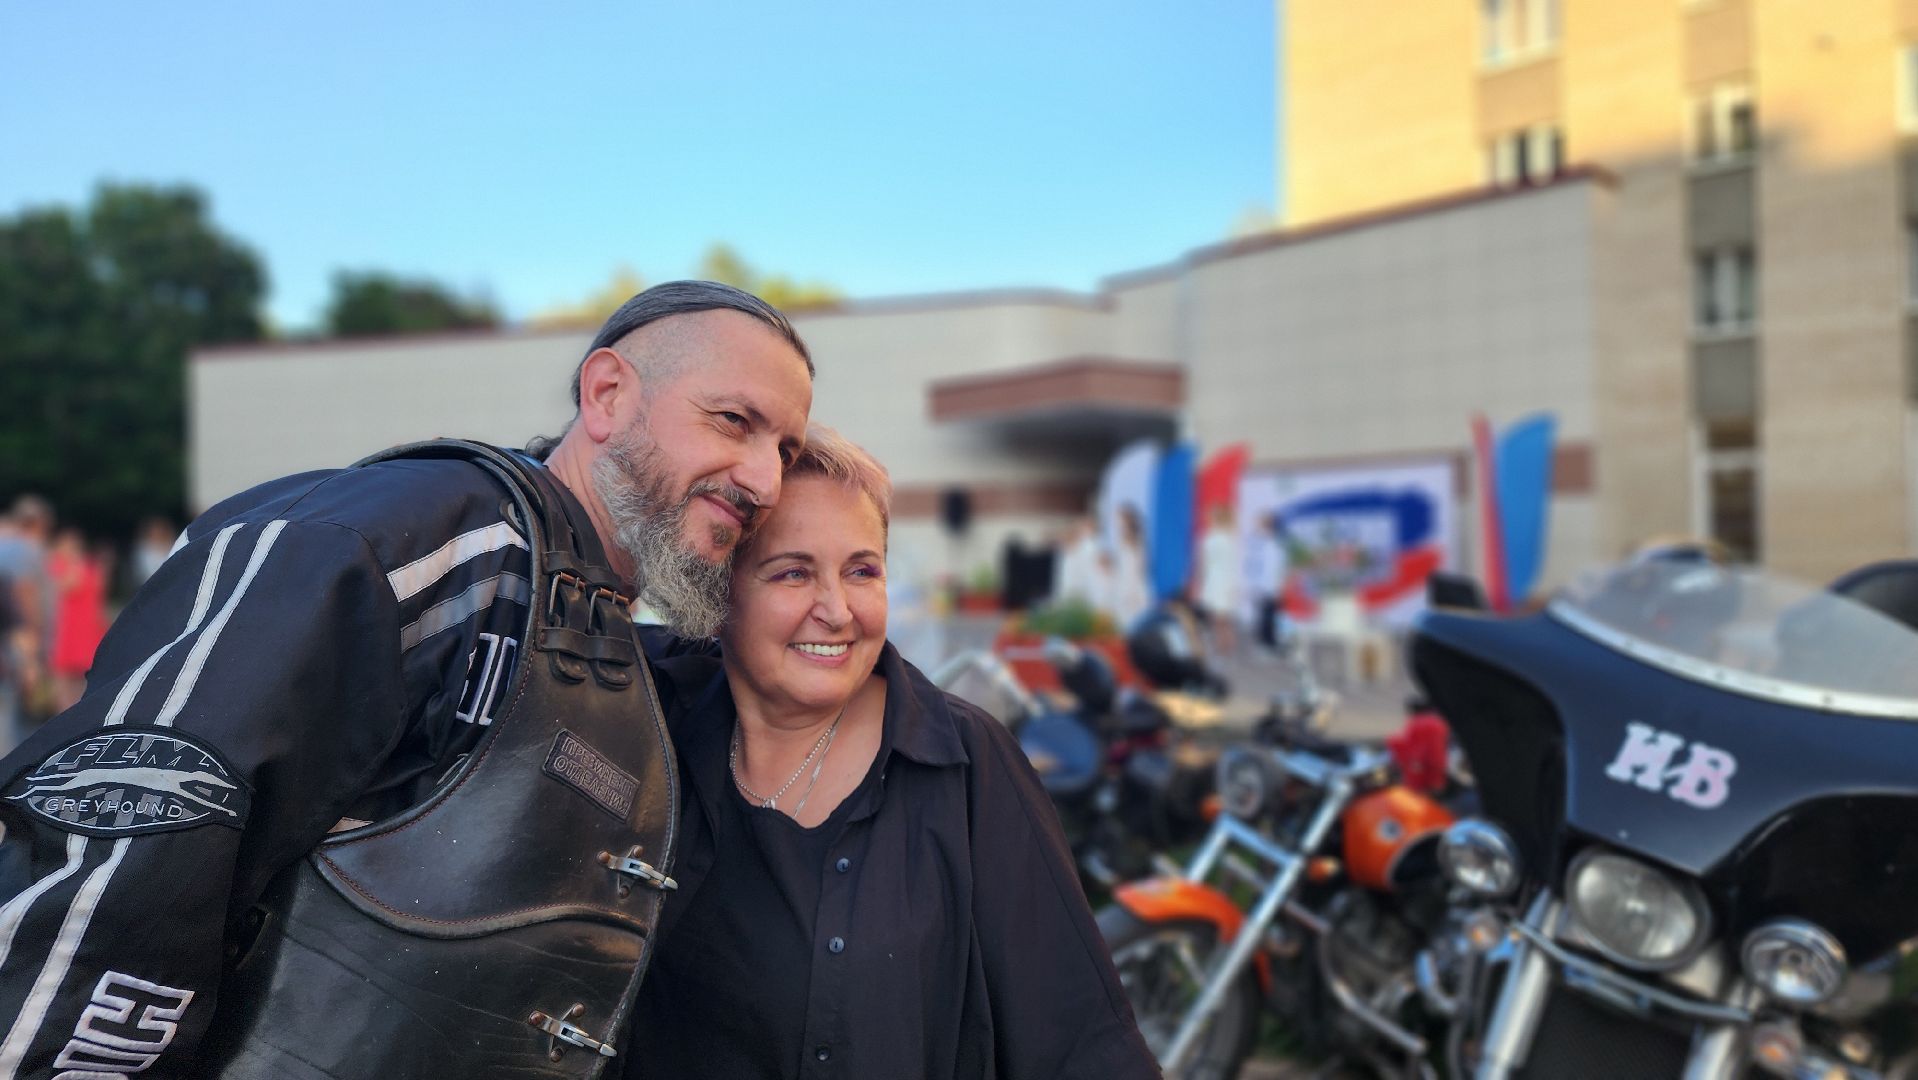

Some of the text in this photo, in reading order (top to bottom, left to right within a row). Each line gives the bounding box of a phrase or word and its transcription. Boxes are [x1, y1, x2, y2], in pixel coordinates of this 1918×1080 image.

[554, 755, 633, 816] ОТДЕЛЕНИЯ
[561, 736, 637, 797] ПРЕЗИДЕНТ
[45, 797, 183, 819] GREYHOUND
